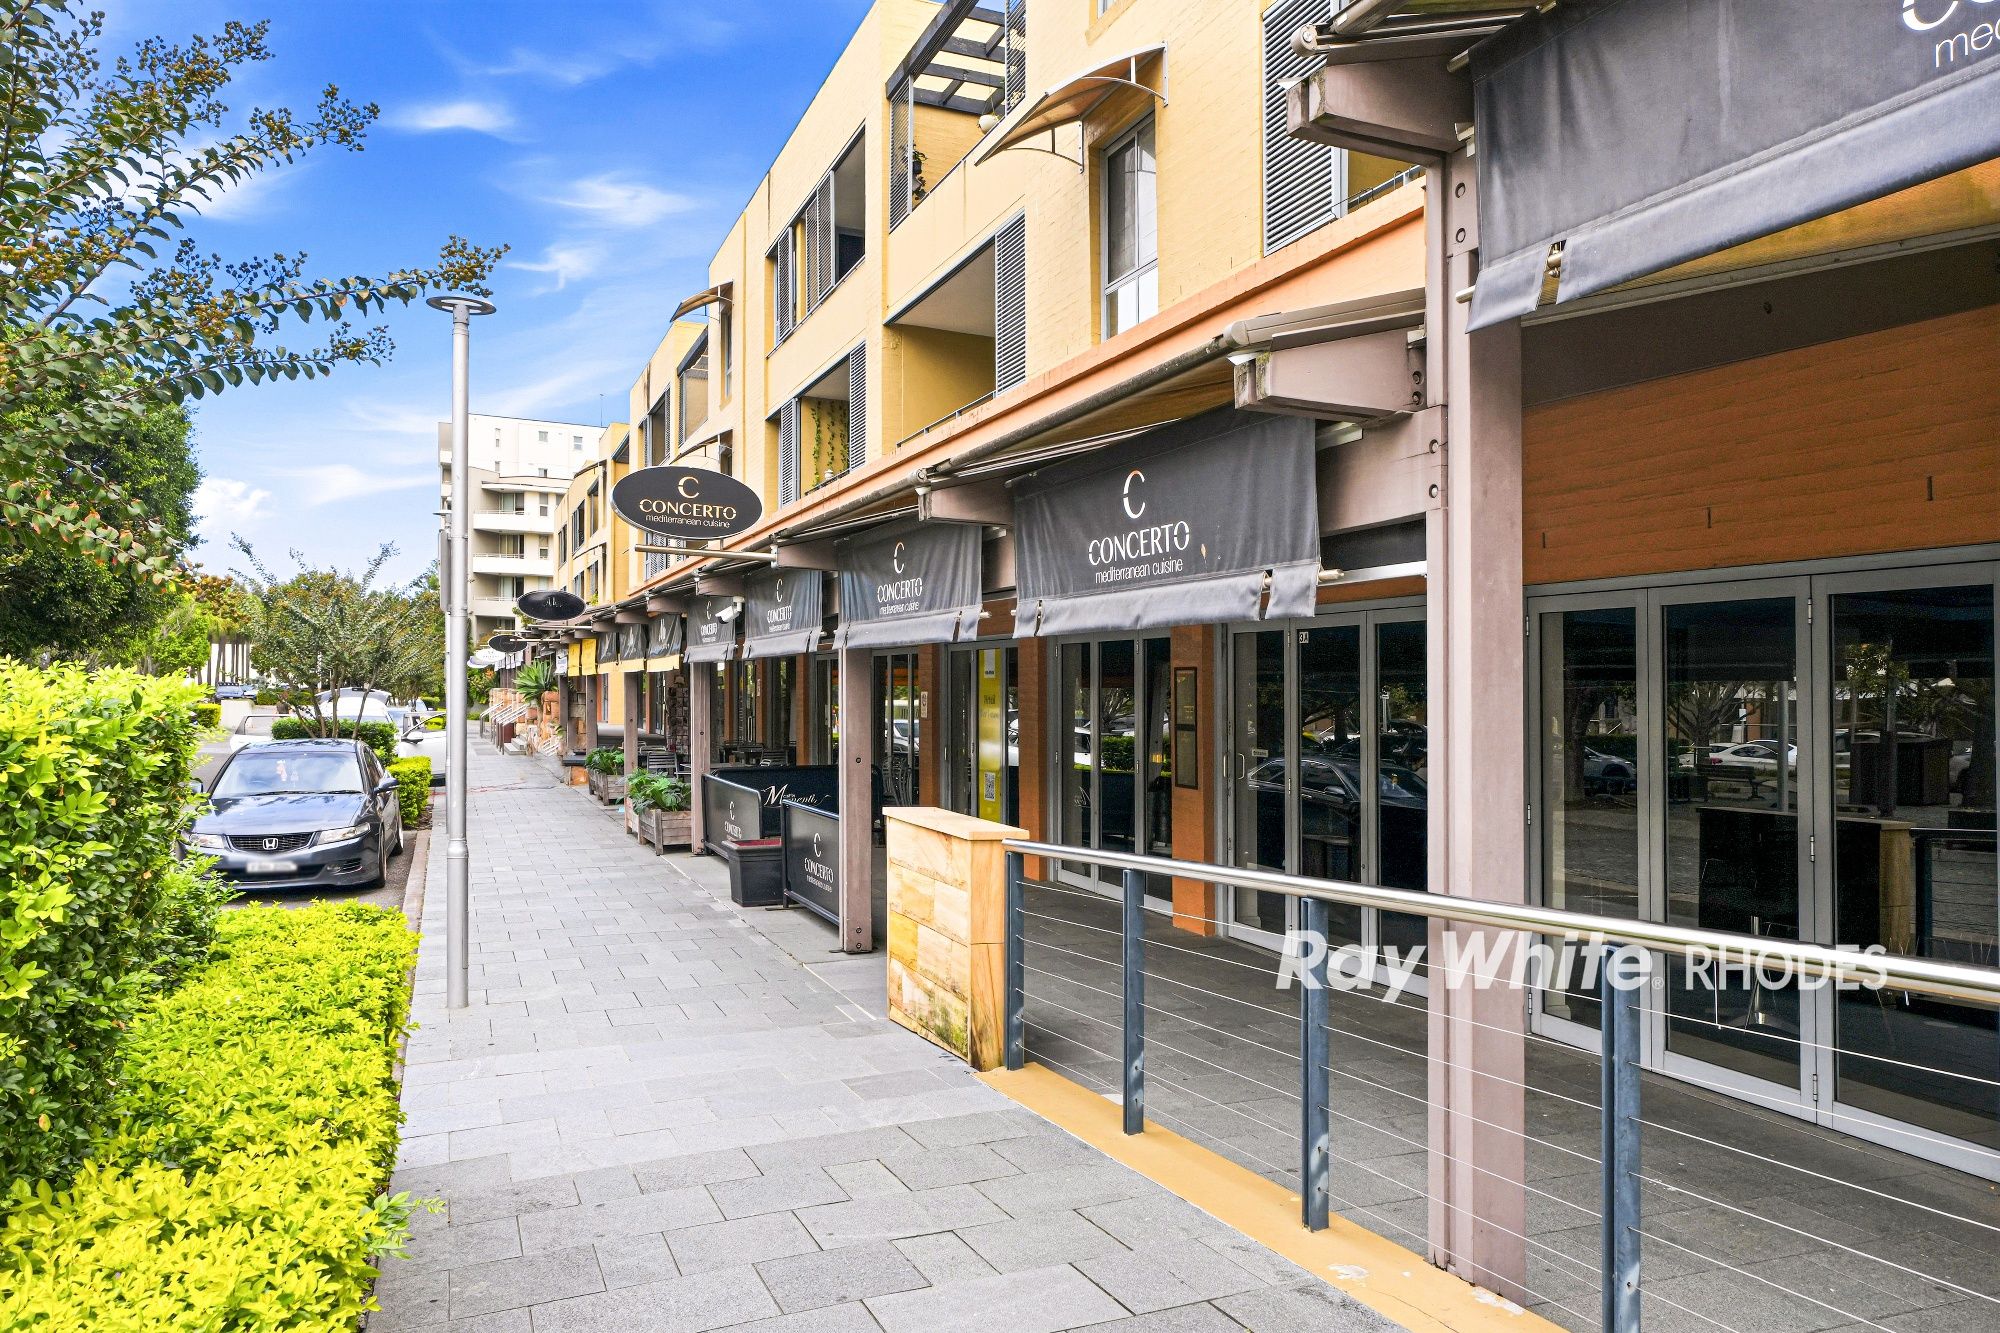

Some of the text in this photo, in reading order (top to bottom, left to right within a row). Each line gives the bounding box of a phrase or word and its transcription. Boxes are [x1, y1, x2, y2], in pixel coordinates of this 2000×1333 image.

[677, 476, 700, 499] C
[1123, 469, 1146, 519] C
[639, 499, 737, 520] CONCERTO
[645, 514, 730, 529] mediterranean cuisine
[1088, 520, 1190, 566] CONCERTO
[893, 542, 905, 573] C
[1095, 556, 1184, 584] mediterranean cuisine
[877, 577, 923, 603] CONCERTO
[767, 604, 792, 624] CONCERTO
[804, 857, 834, 884] CONCERTO
